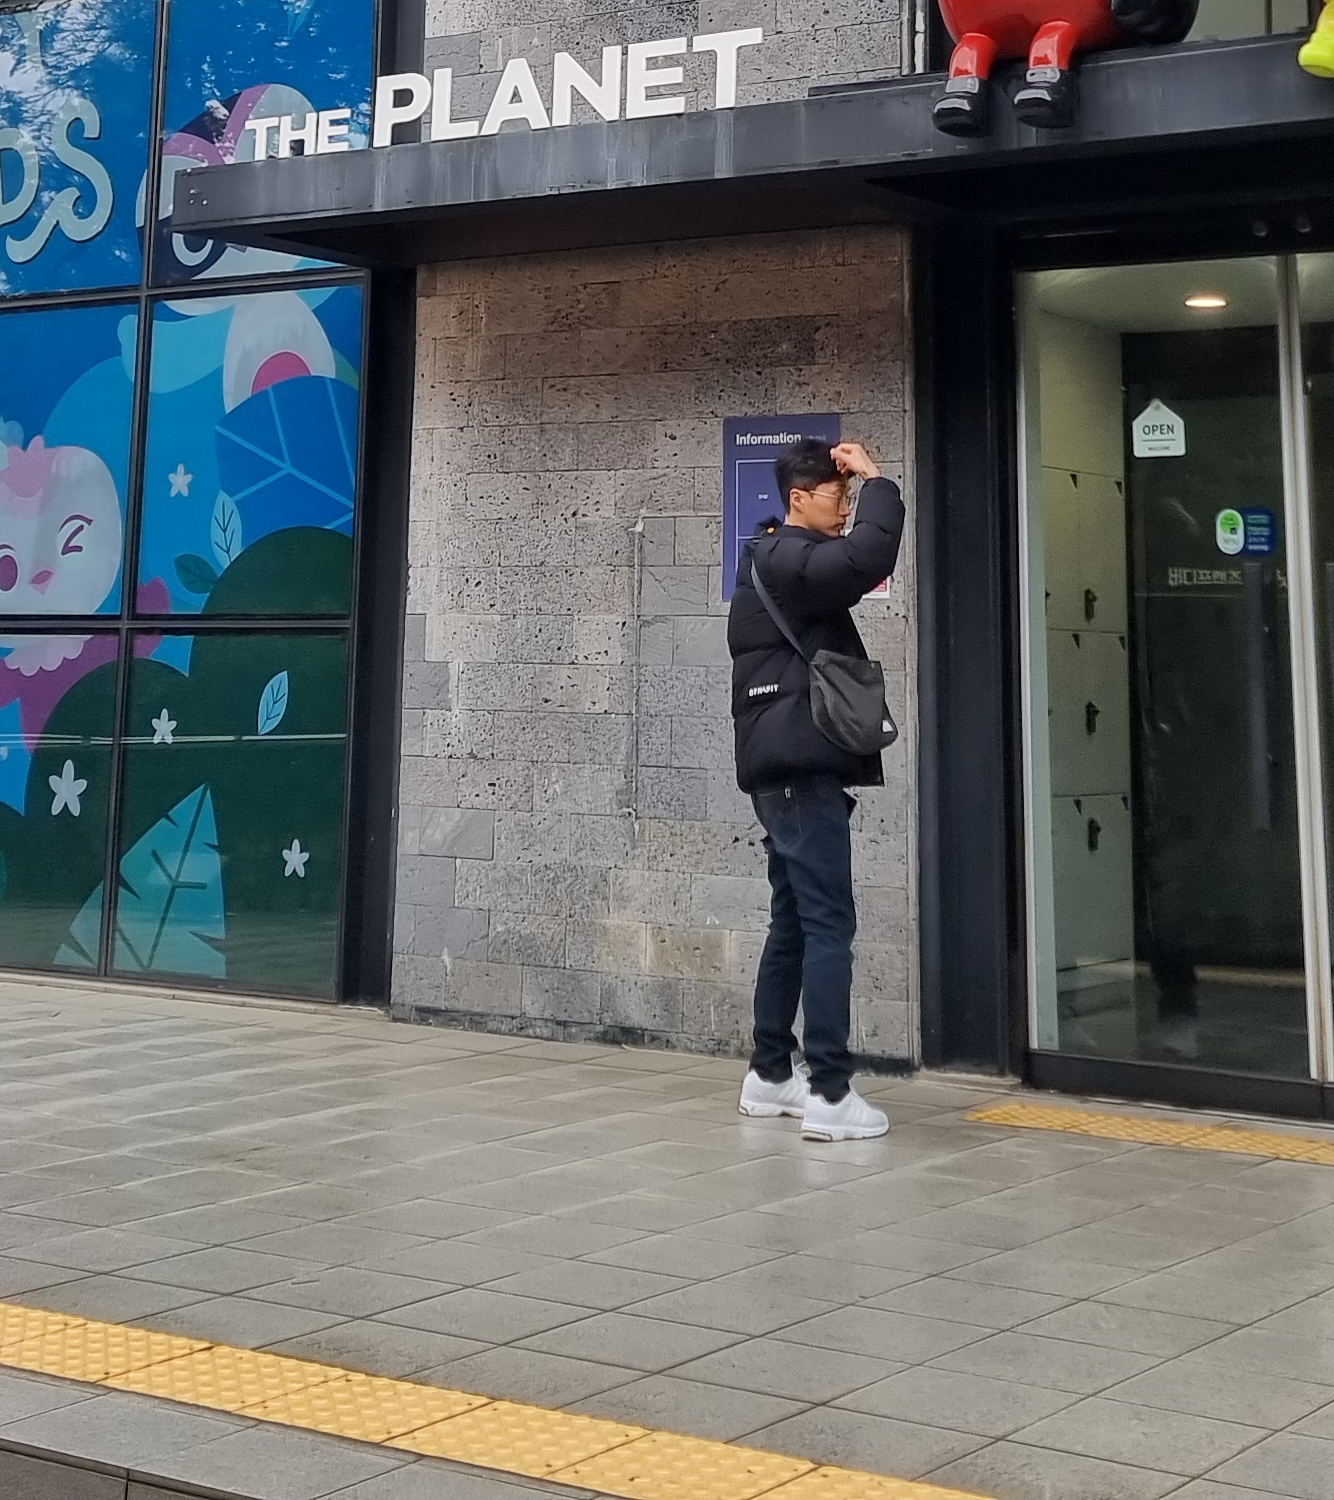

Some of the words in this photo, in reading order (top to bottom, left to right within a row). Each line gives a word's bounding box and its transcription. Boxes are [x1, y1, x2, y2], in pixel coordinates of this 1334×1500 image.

[244, 107, 352, 161] THE
[372, 26, 764, 148] PLANET
[1142, 424, 1175, 436] OPEN
[736, 432, 802, 446] Information
